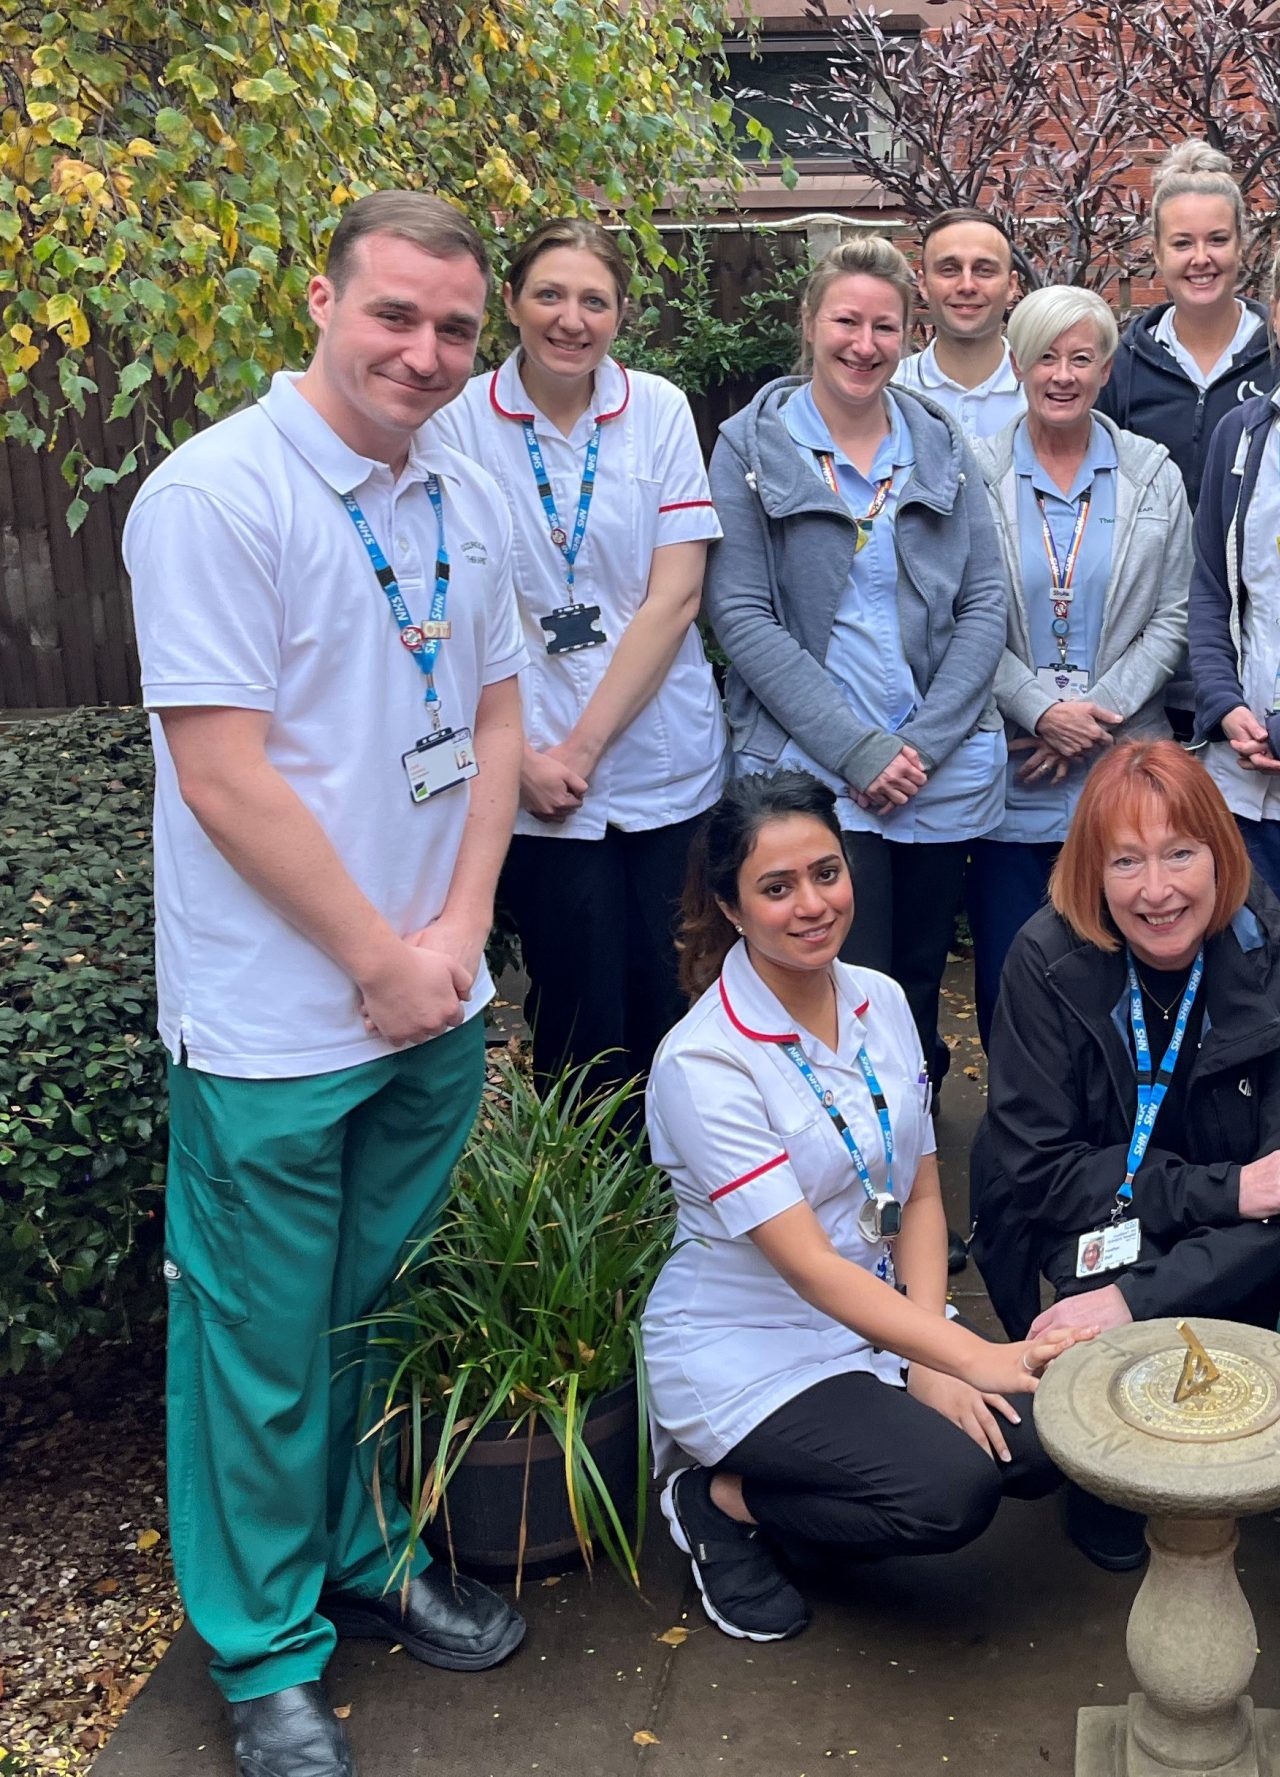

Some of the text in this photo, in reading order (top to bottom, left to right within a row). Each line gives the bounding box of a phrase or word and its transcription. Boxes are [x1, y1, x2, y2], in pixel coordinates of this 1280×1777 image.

[525, 428, 543, 469] NHS NHS
[587, 453, 597, 472] NHS
[577, 508, 587, 528] NHS
[356, 520, 375, 545] NHS
[391, 596, 409, 621] NHS
[432, 593, 444, 620] NHS
[1189, 969, 1201, 993] NHS
[1133, 998, 1142, 1021] NHS
[1180, 998, 1191, 1022] NHS
[1136, 1028, 1148, 1052] NHS
[1171, 1028, 1183, 1052] NHS
[788, 1046, 822, 1094] NHS NHS
[860, 1055, 874, 1077] NHS
[884, 1129, 893, 1153] NHS
[1134, 1102, 1158, 1157] NHS NHS
[851, 1150, 876, 1200] NHS NHS
[1086, 1431, 1132, 1459] N
